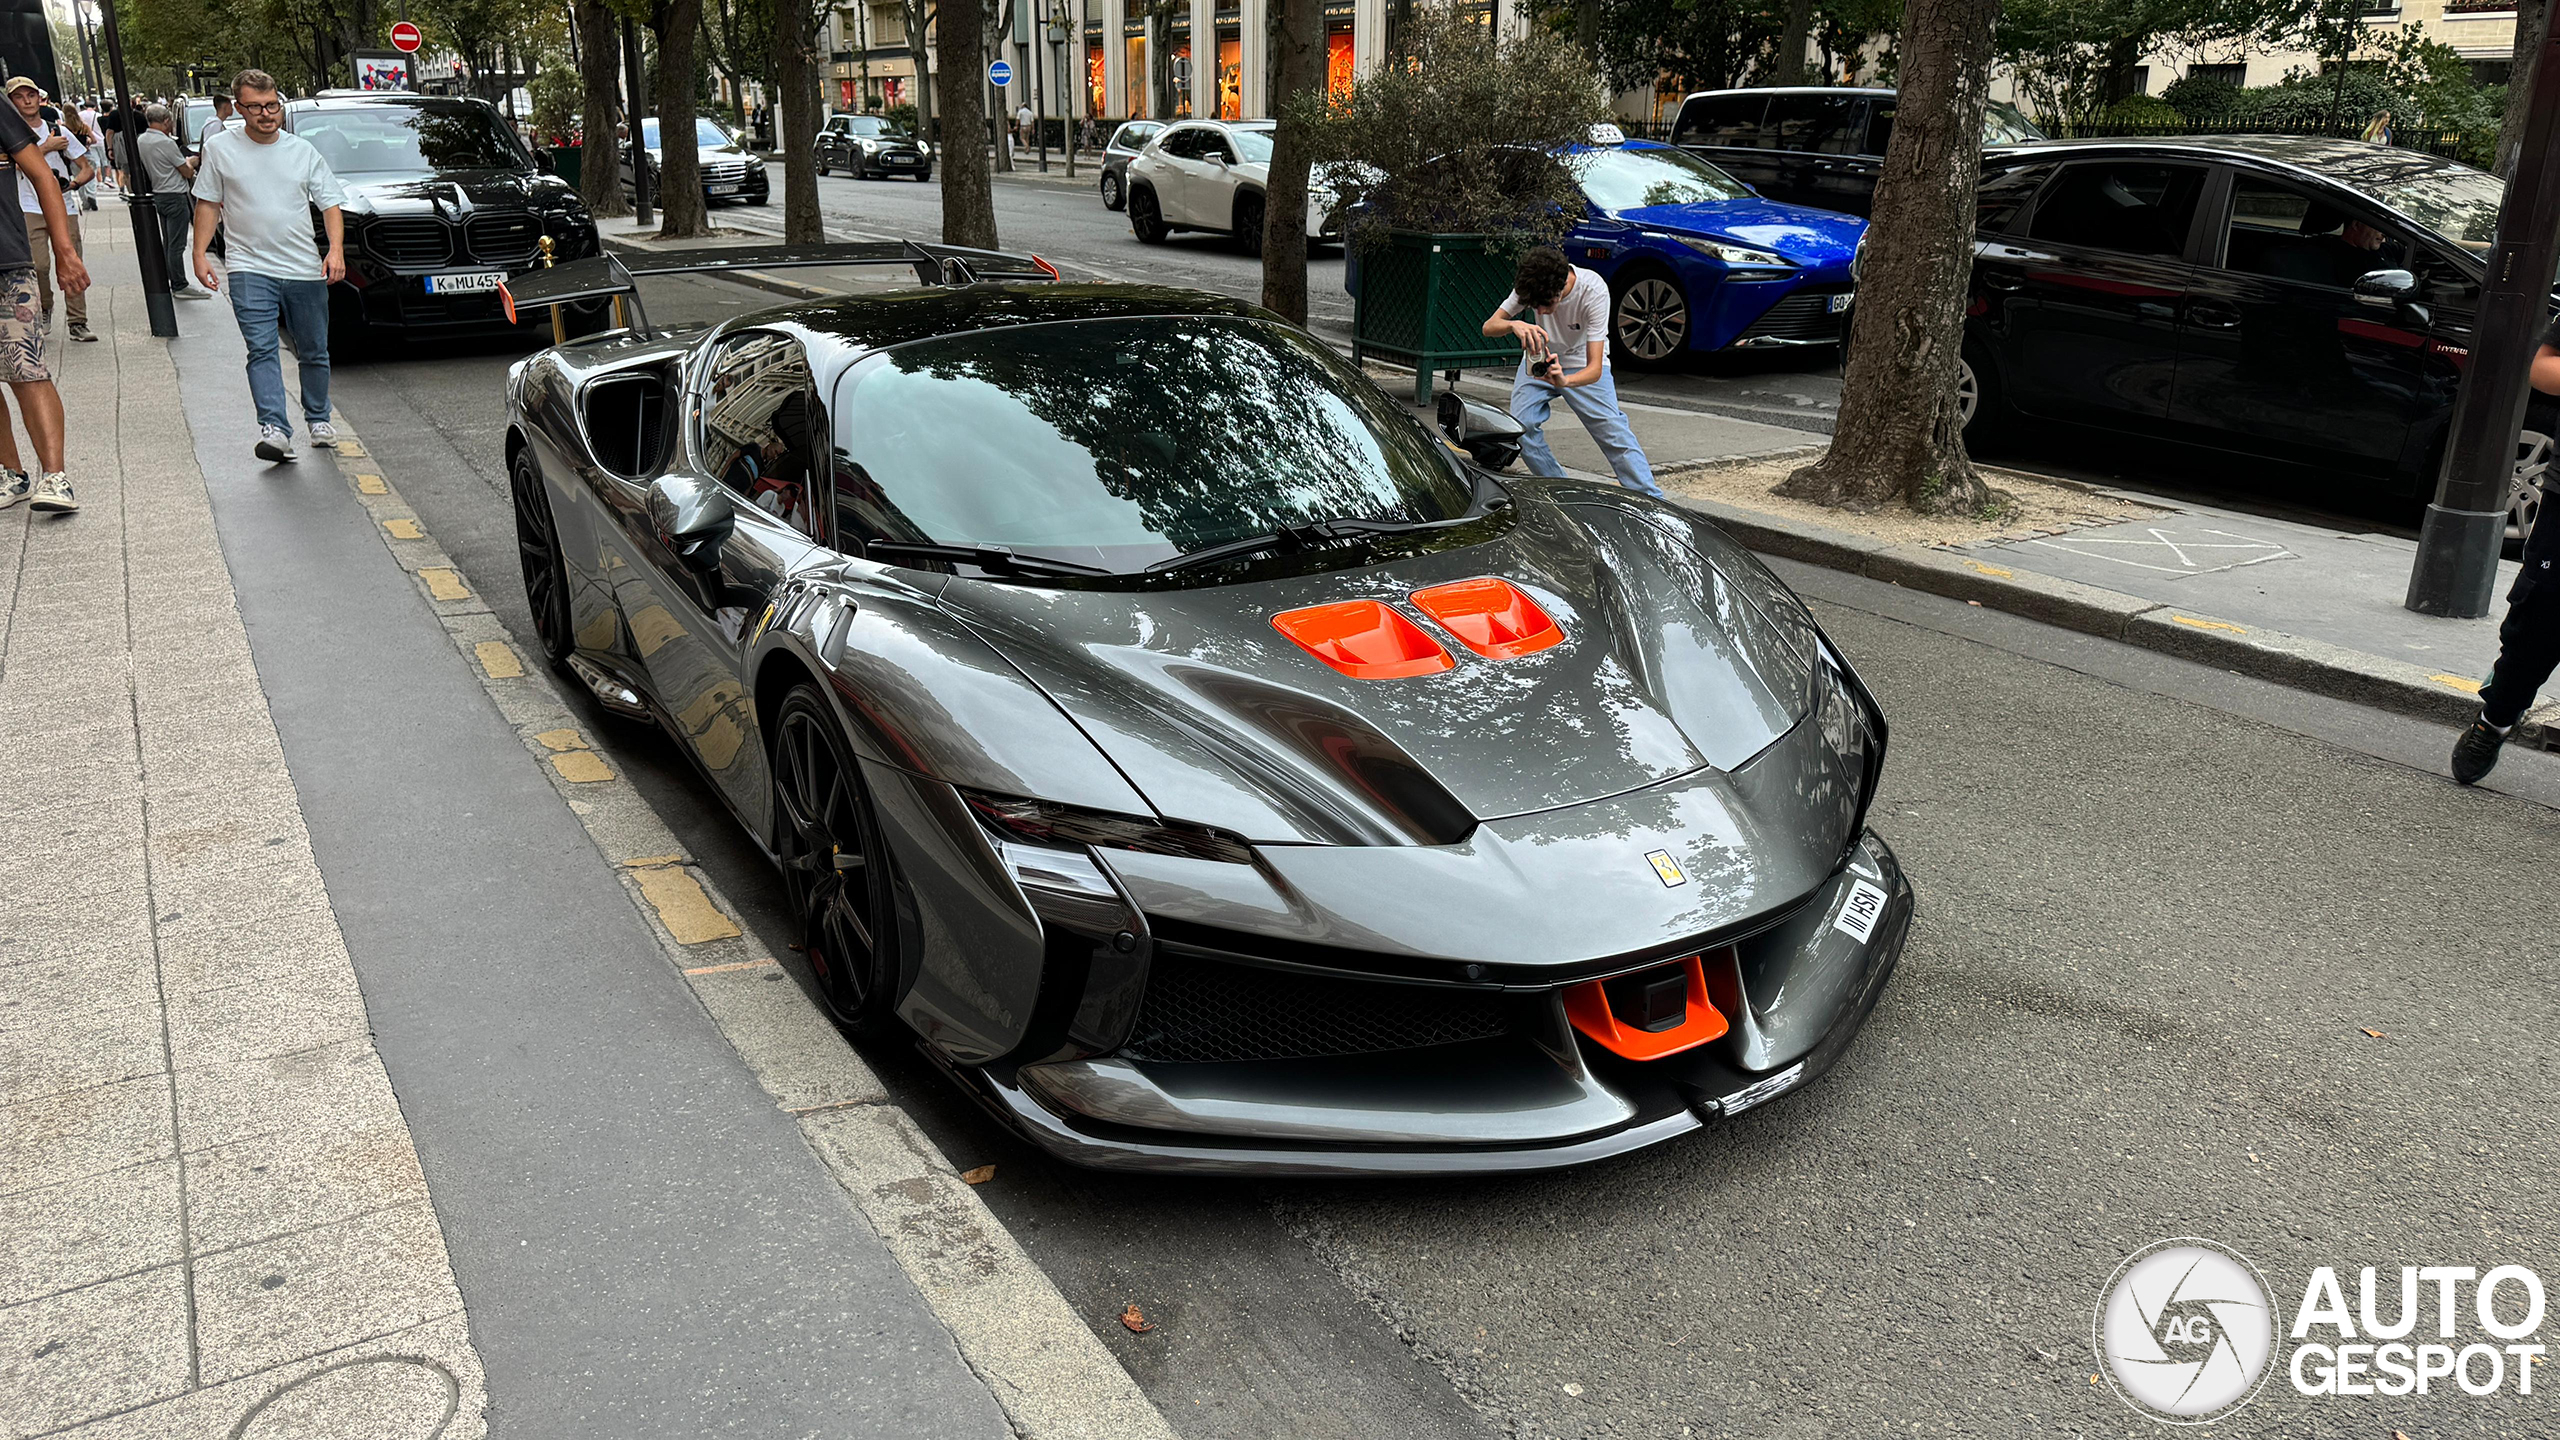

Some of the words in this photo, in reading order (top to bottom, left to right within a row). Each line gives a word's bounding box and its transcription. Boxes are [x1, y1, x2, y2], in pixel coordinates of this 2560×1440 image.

[436, 278, 447, 291] K
[455, 276, 475, 290] MU
[477, 274, 501, 288] 453
[1849, 887, 1880, 920] HSN
